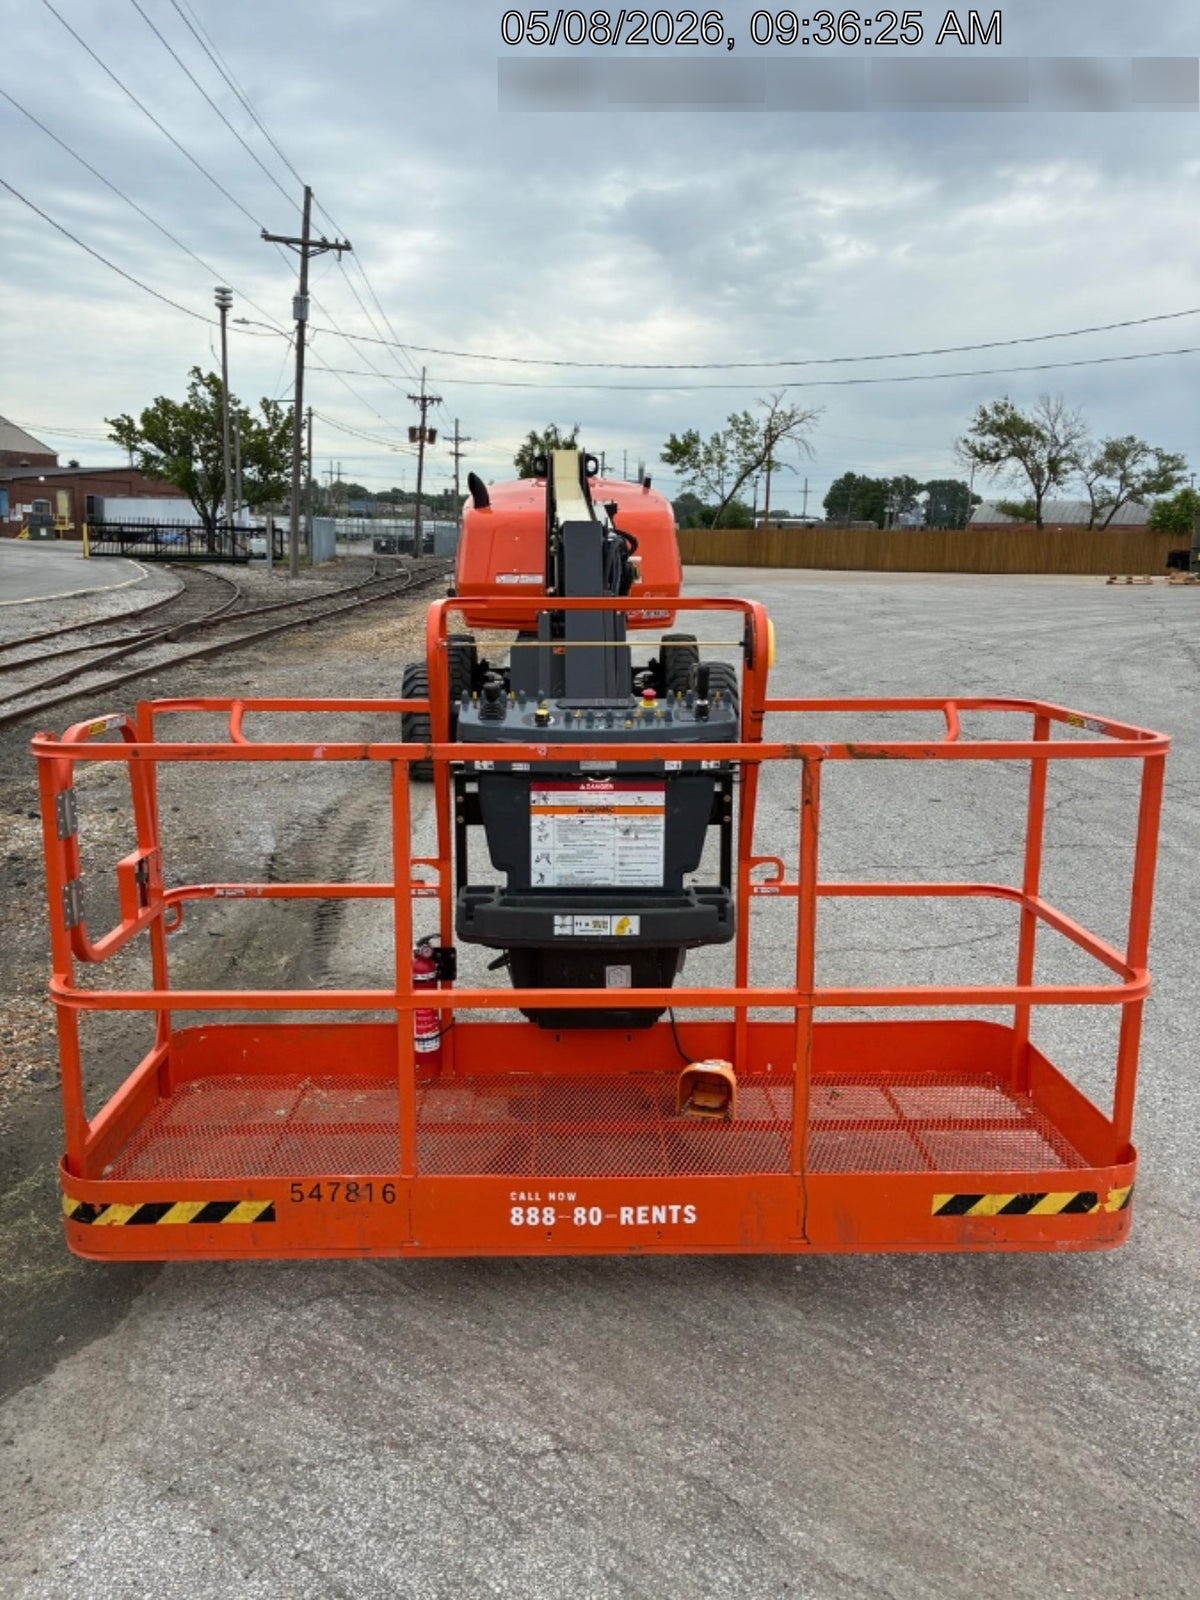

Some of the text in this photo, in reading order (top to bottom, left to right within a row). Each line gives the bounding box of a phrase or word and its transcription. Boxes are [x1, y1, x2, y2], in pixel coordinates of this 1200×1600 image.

[290, 1182, 396, 1204] 547816
[509, 1191, 577, 1202] CALL NOW
[509, 1204, 697, 1226] 888-80-RENTS
